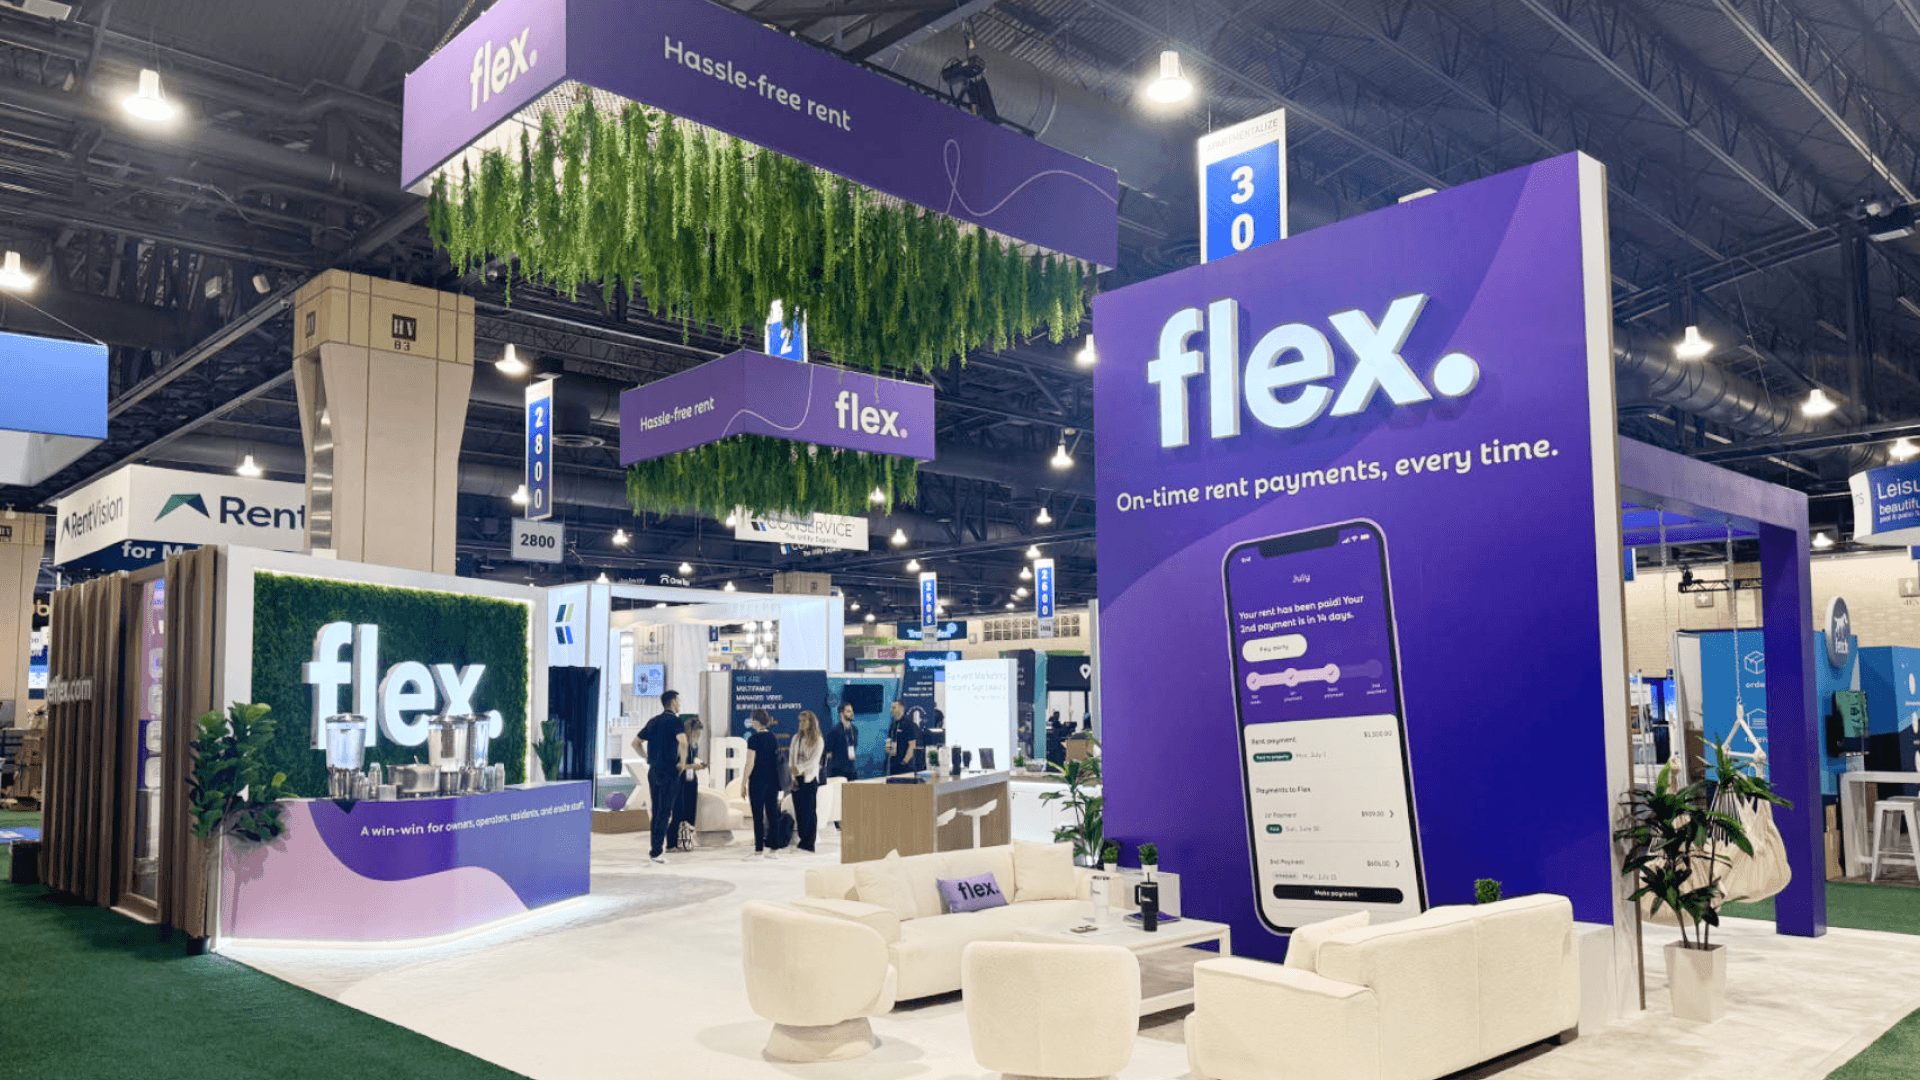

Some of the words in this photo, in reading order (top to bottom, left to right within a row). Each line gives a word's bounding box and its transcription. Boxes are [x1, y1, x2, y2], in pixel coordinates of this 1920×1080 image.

[469, 26, 538, 112] flex.
[664, 35, 801, 111] Hassle-free
[807, 98, 852, 131] rent
[1147, 293, 1480, 449] flex.
[639, 402, 692, 432] Hassle-free
[694, 396, 715, 415] rent
[835, 390, 908, 439] flex.
[1116, 485, 1200, 512] On-time
[1205, 477, 1248, 501] rent
[1254, 461, 1388, 499] payments,
[1395, 450, 1472, 476] every
[1479, 437, 1559, 466] time.
[70, 495, 123, 539] RentVision
[121, 541, 155, 559] for
[520, 533, 555, 549] 2800
[1238, 610, 1258, 620] Your
[1277, 606, 1293, 615] has
[1294, 602, 1316, 612] been
[1343, 595, 1364, 605] Your
[1240, 623, 1257, 633] 2nd
[1258, 617, 1297, 632] payment
[1298, 615, 1306, 625] is
[1306, 615, 1316, 624] in
[360, 826, 370, 837] A
[371, 825, 424, 837] win-win
[427, 822, 444, 833] for
[957, 881, 1000, 901] flex.
